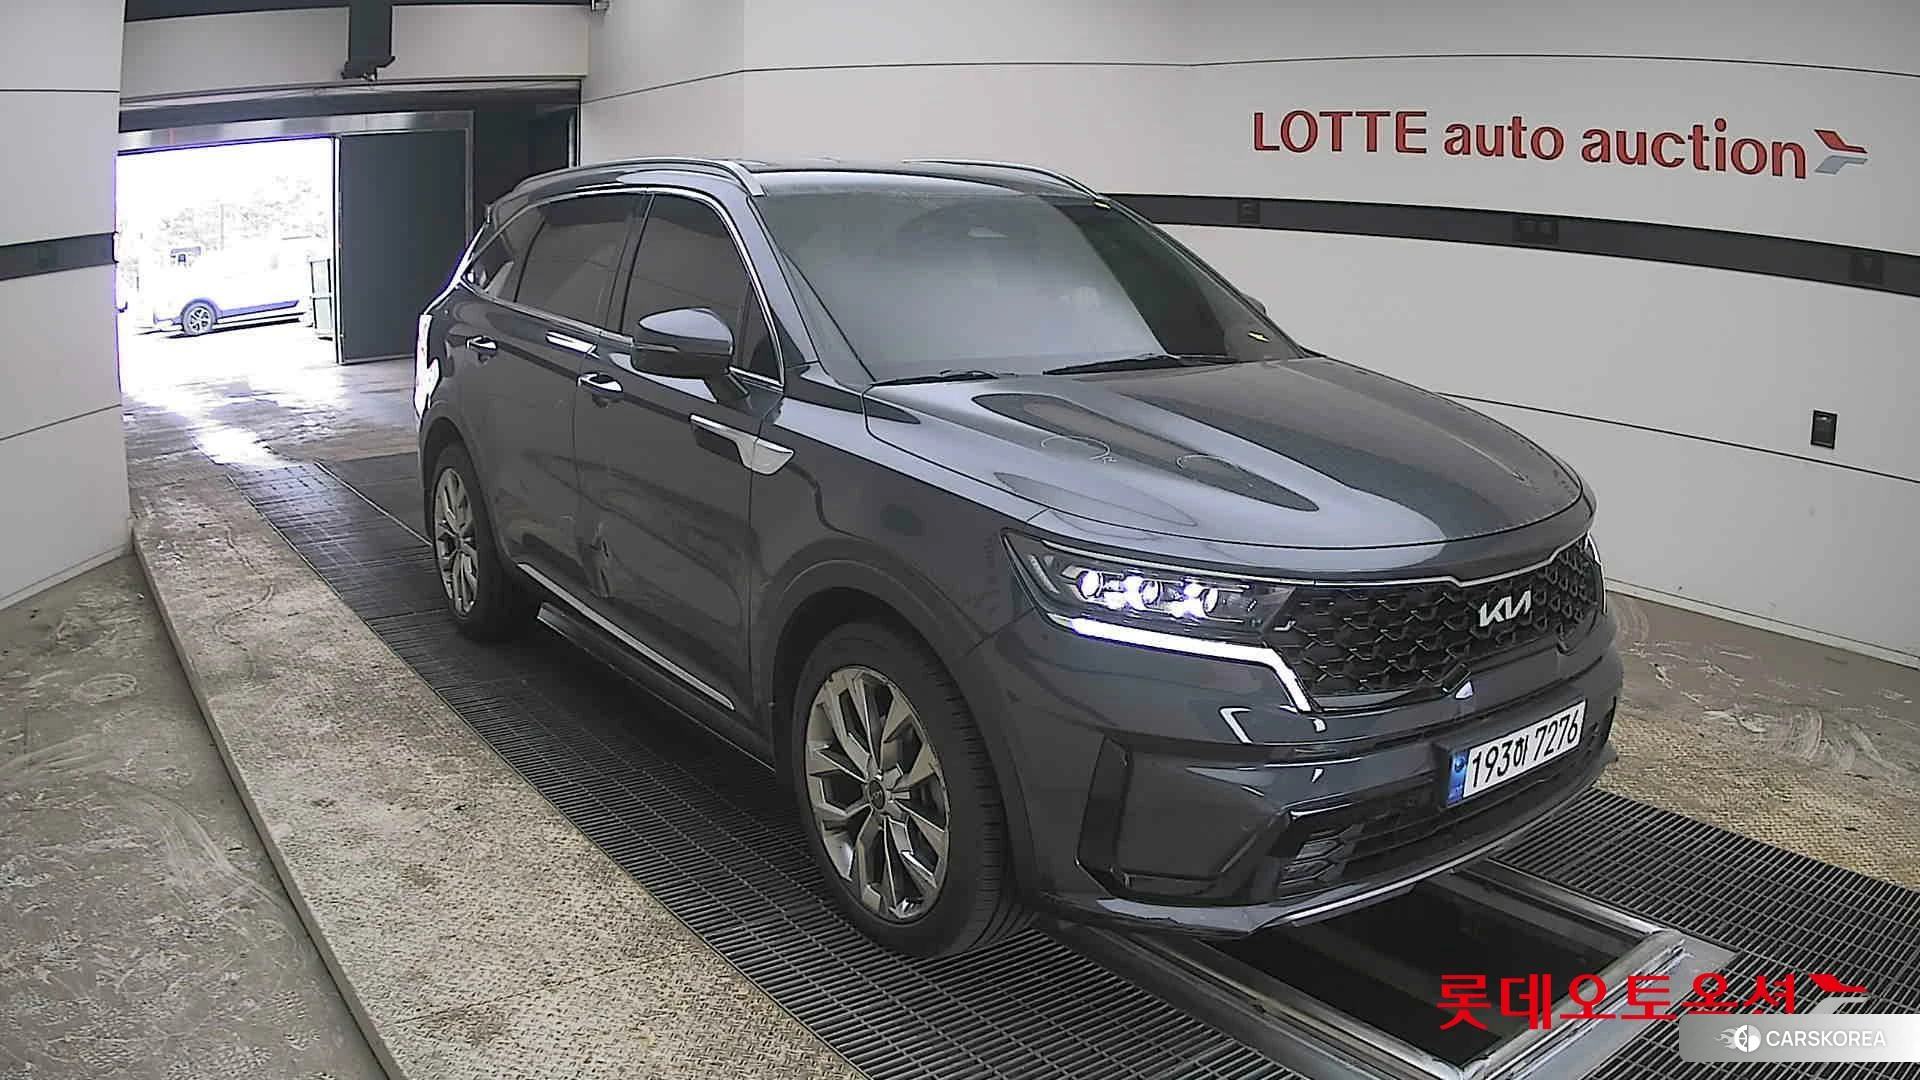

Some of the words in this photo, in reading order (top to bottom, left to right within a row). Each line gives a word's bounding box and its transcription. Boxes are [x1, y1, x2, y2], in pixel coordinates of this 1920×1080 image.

[1253, 110, 1427, 154] LOTTE
[1444, 115, 1565, 160] auto
[1581, 118, 1807, 179] auction
[1533, 709, 1580, 762] 7276
